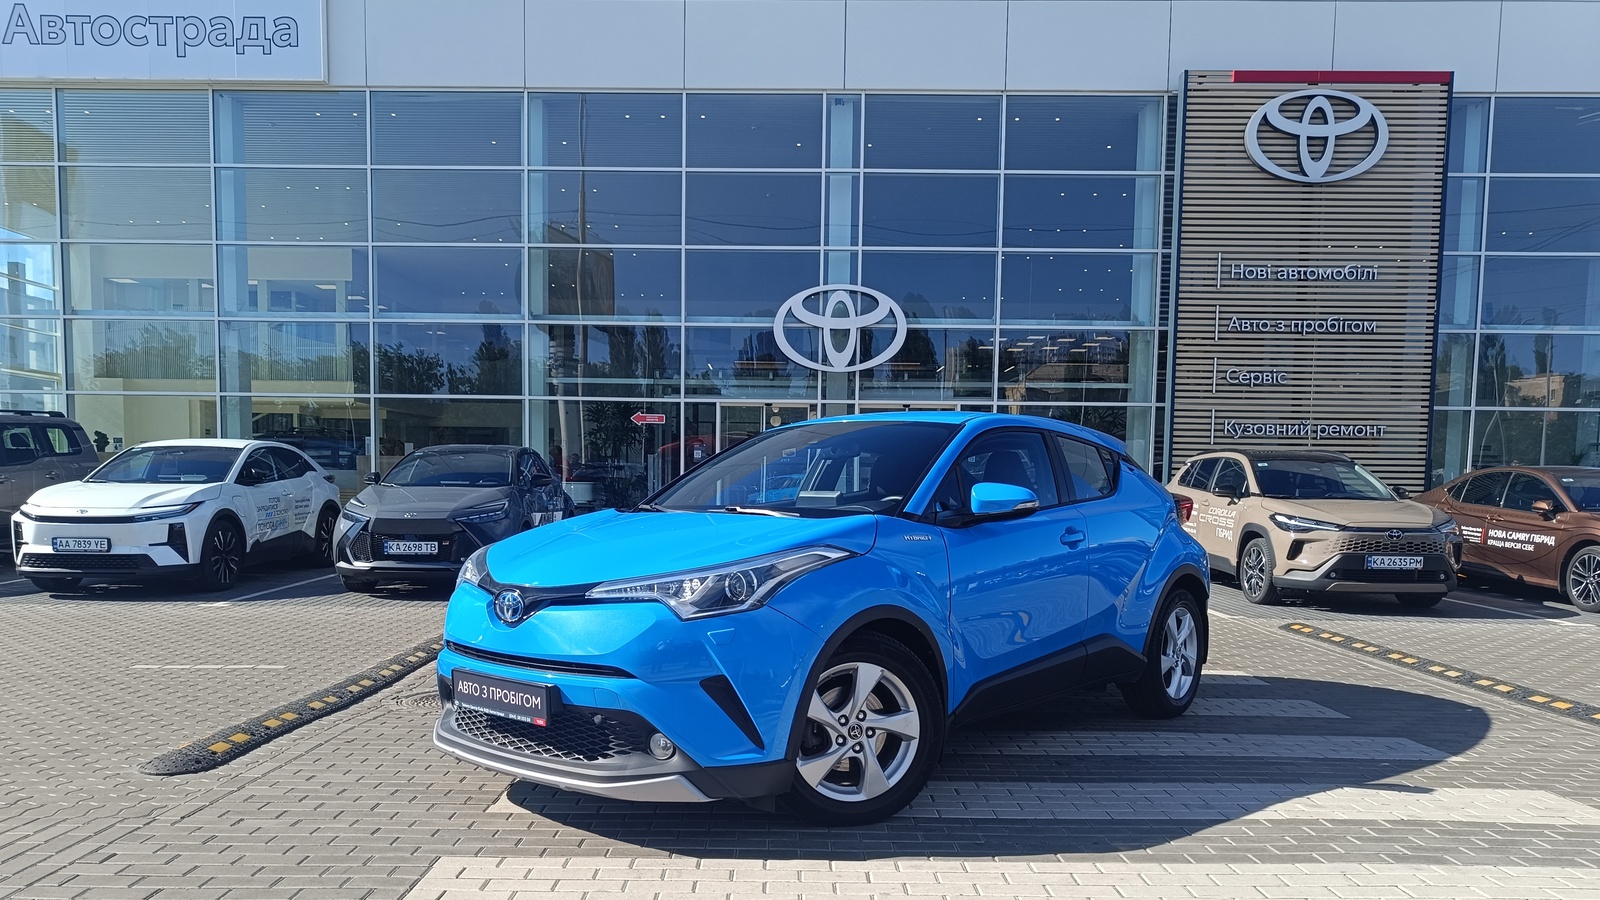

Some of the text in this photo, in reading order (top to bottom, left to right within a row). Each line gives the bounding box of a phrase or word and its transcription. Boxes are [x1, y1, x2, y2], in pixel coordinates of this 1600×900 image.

[2, 3, 299, 57] Автострада
[1231, 264, 1379, 280] Нові автомобілі
[1227, 316, 1377, 336] Авто з пробігом
[1226, 368, 1288, 388] Сервіс
[1224, 420, 1387, 439] Кузовний ремонт
[1199, 513, 1235, 528] CROSS
[1208, 506, 1236, 519] COROLLA
[58, 539, 106, 549] AA 7839 YE
[1487, 538, 1505, 548] КРАЩА
[1521, 543, 1535, 552] СЕБЕ
[1488, 528, 1506, 539] НОВА
[1506, 530, 1531, 542] CAMRY
[1530, 533, 1556, 547] ГІБРИД
[388, 543, 401, 552] KA
[402, 543, 423, 552] 2698
[424, 543, 437, 552] TB
[1373, 557, 1423, 567] KA 2635 PM
[457, 680, 480, 697] АВТО
[481, 685, 488, 698] З
[489, 687, 541, 710] ПРОБІГОМ
